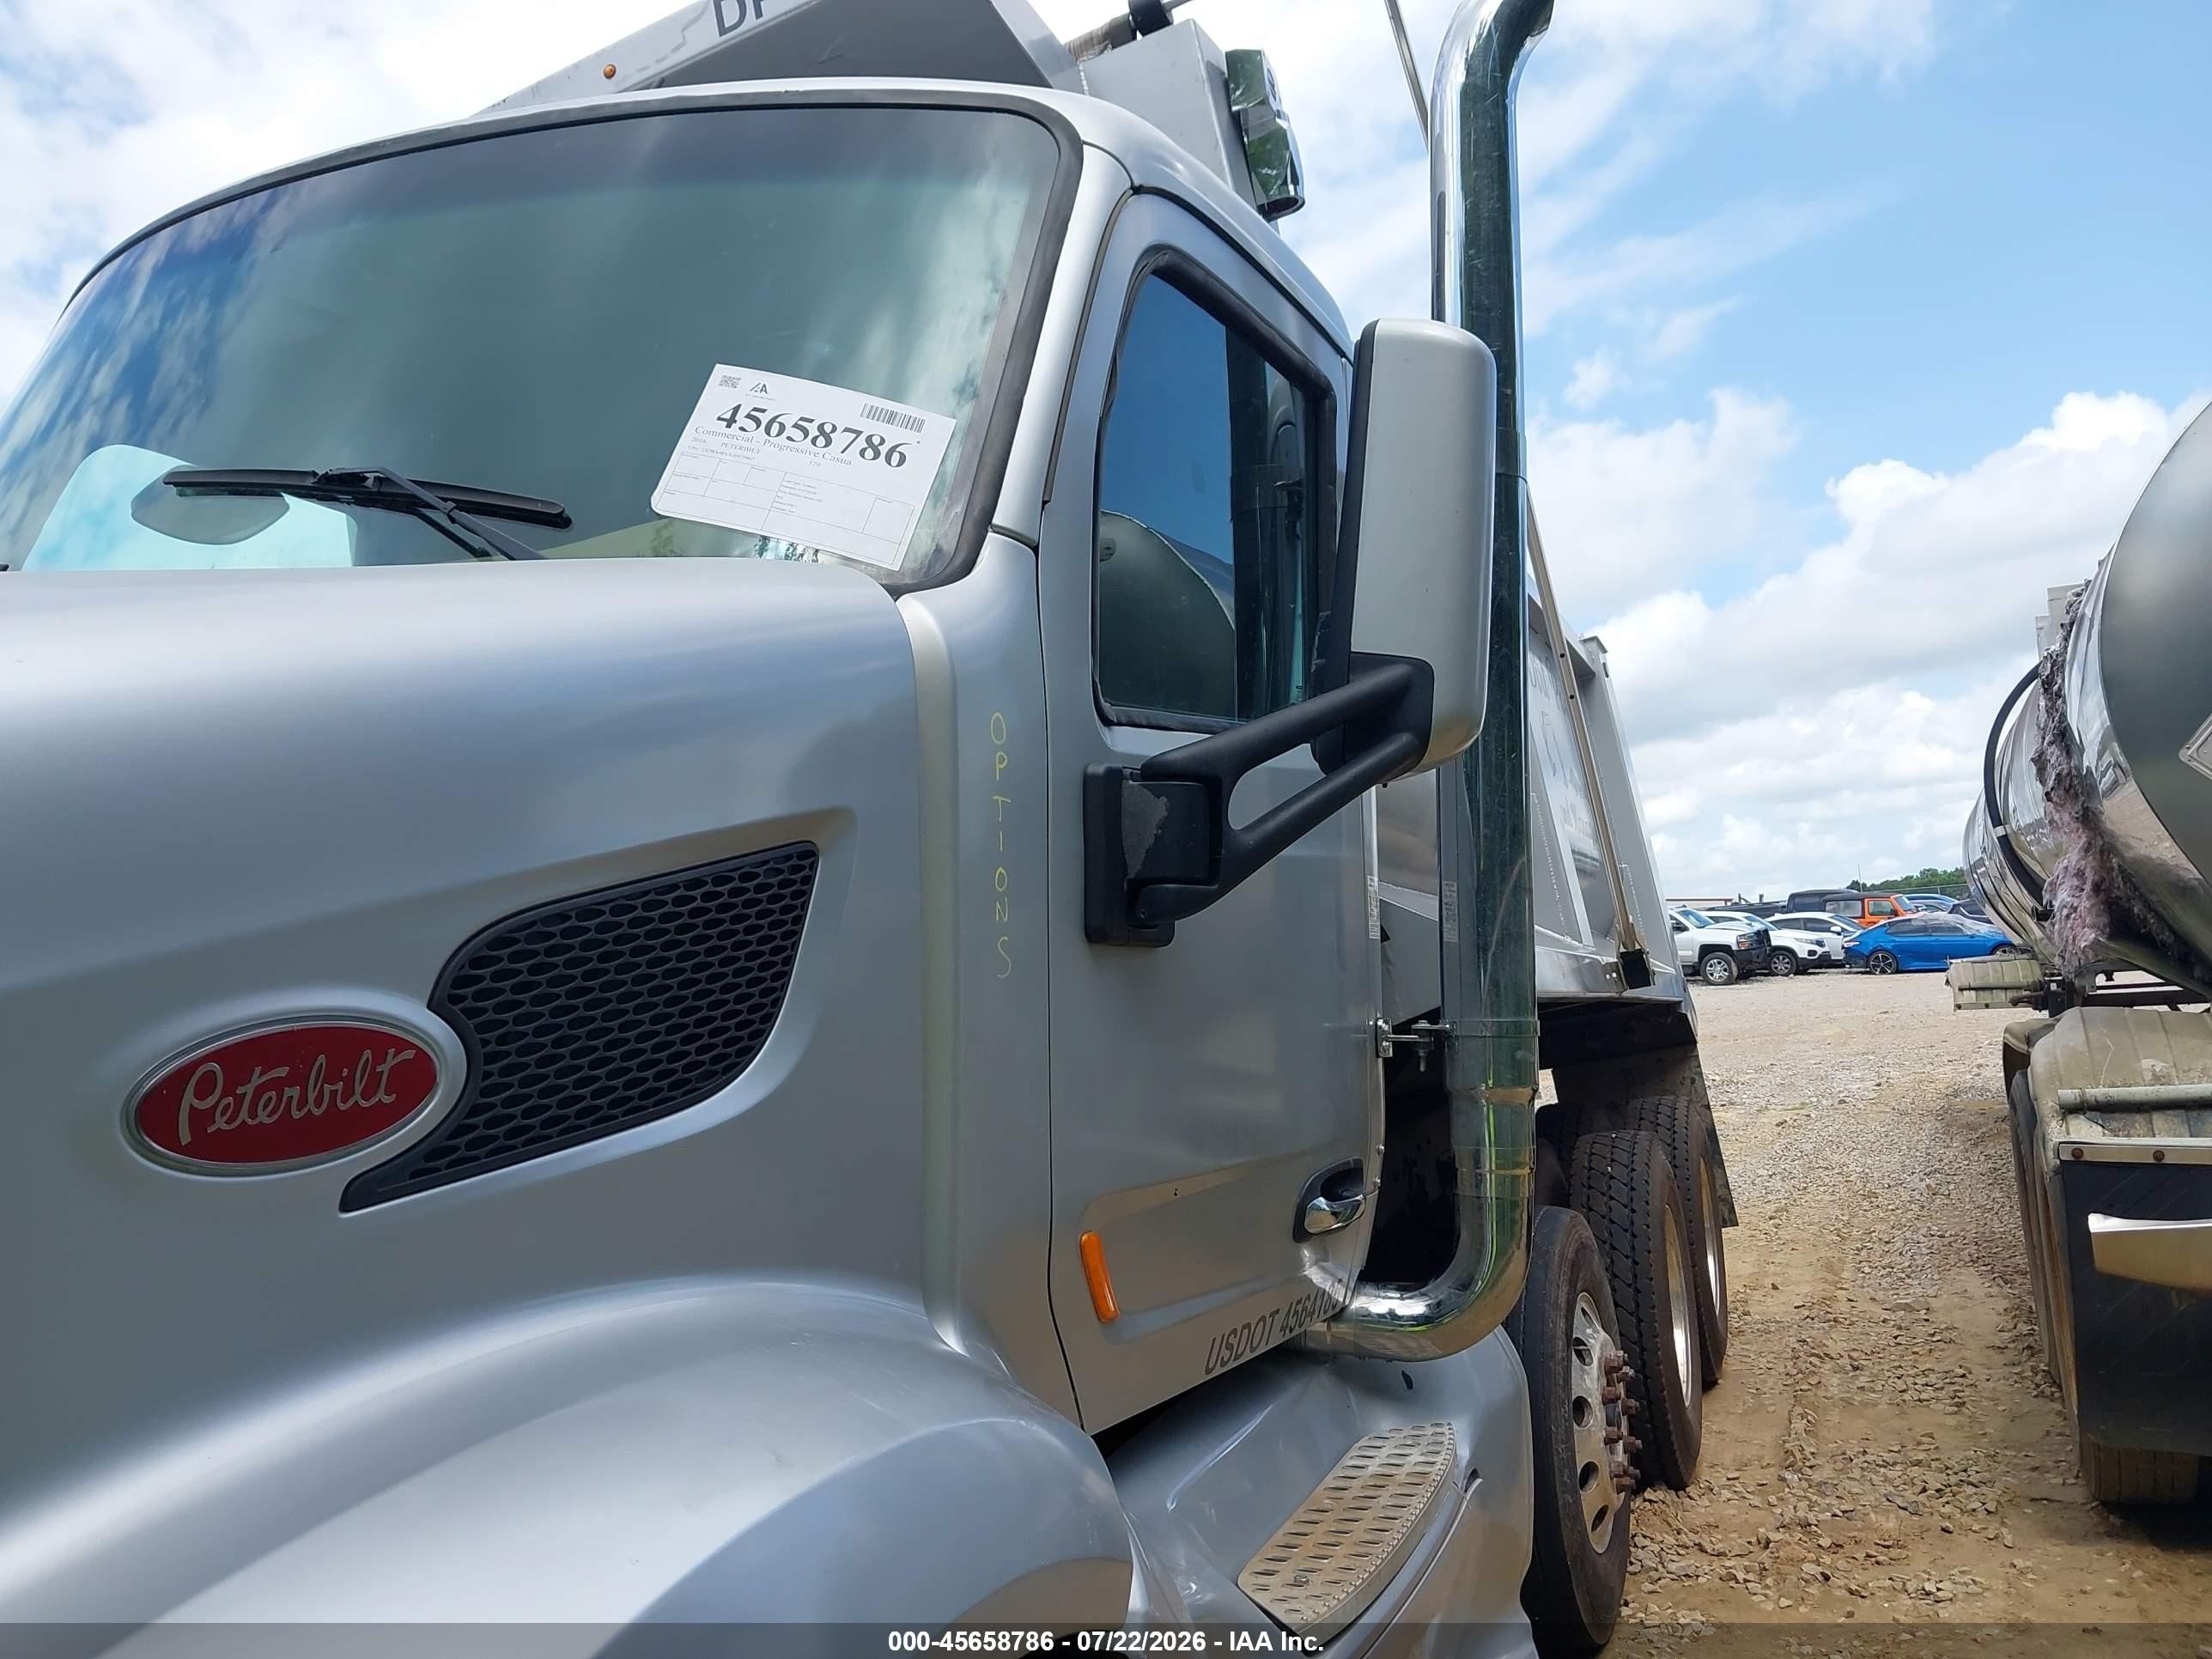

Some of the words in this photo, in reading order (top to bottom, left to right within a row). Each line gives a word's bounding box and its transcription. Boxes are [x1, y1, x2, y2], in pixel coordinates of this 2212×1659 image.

[695, 426, 754, 444] Commercial
[763, 439, 820, 458] Progressive
[822, 452, 852, 465] Casua
[716, 403, 914, 468] 45658786
[990, 712, 1012, 979] OPTIONS
[178, 1048, 416, 1146] Peterbilt
[1205, 1308, 1280, 1376] USDOT
